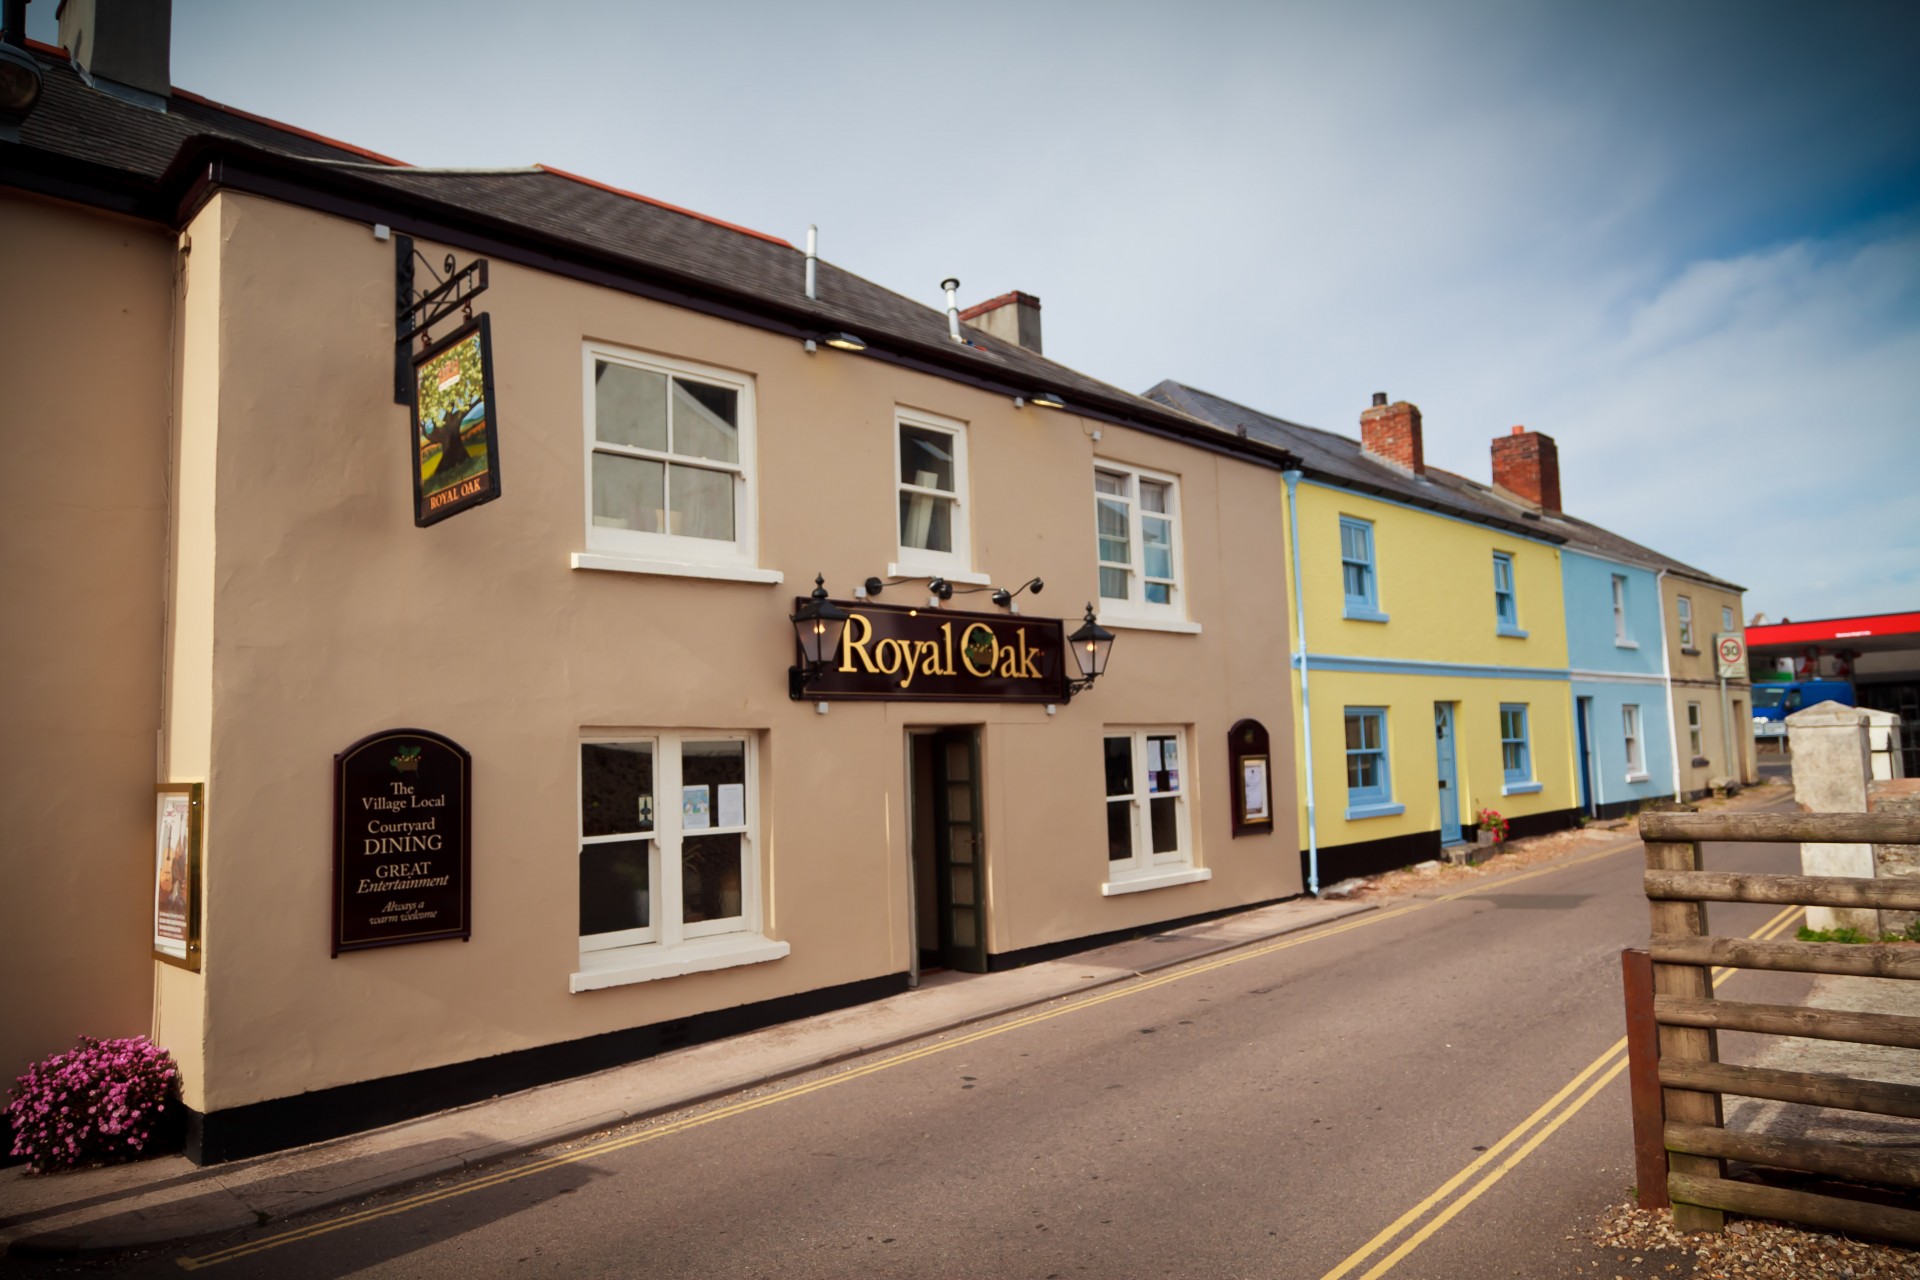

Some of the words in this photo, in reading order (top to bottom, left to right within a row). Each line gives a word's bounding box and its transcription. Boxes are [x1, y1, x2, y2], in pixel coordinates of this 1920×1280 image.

[430, 488, 459, 510] ROYAL
[461, 478, 481, 497] OAK
[838, 613, 957, 688] Royal
[961, 622, 1043, 679] Oak
[1723, 645, 1739, 656] 30
[390, 782, 414, 795] The
[362, 797, 407, 813] Village
[411, 795, 445, 808] Local
[367, 817, 436, 835] Courtyard
[364, 835, 443, 855] DINING
[376, 862, 432, 878] GREAT
[357, 875, 450, 894] Entertainment
[381, 901, 417, 914] Always
[417, 901, 425, 909] a
[369, 915, 398, 925] warm
[400, 910, 438, 922] welcome
